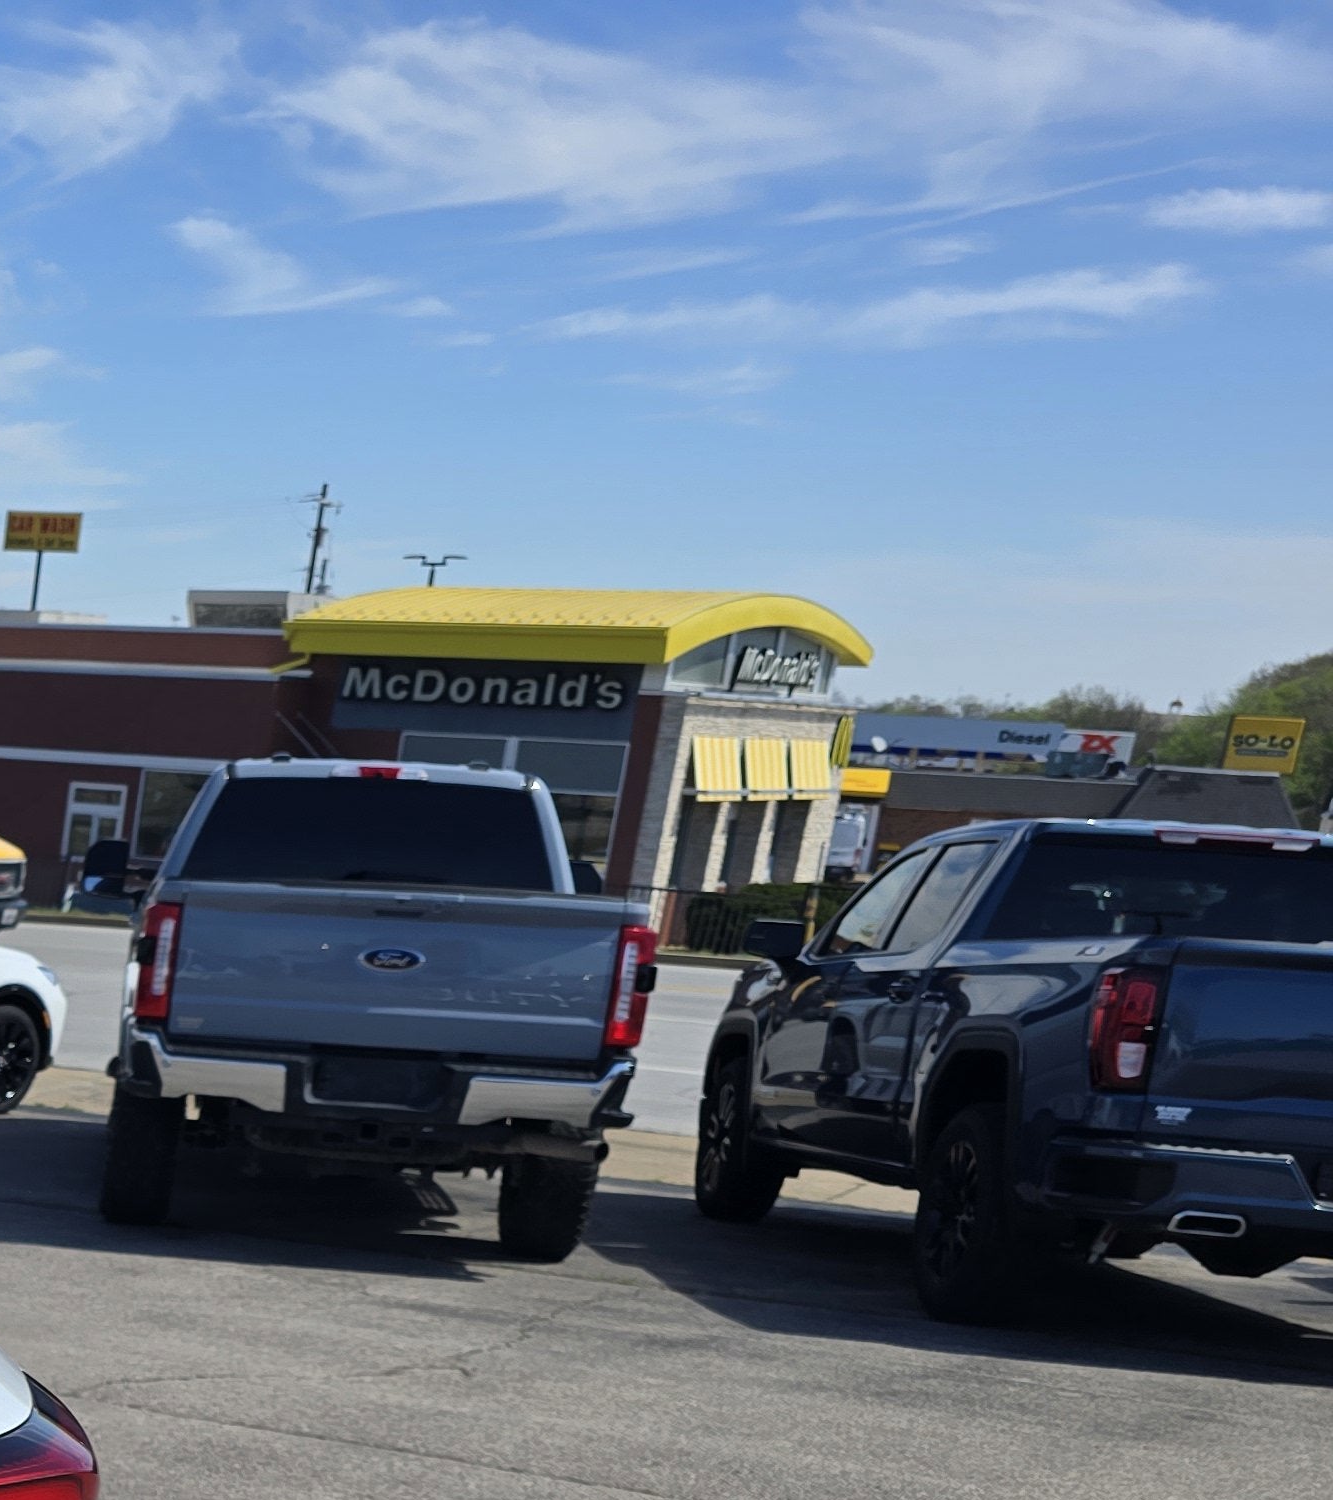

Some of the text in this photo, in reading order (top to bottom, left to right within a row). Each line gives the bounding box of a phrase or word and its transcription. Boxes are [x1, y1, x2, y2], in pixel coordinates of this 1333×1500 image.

[40, 516, 77, 535] WASH
[736, 645, 821, 687] McDonald's
[341, 666, 624, 710] McDonald's
[997, 729, 1052, 746] Diesel
[1233, 733, 1296, 750] SO-LO
